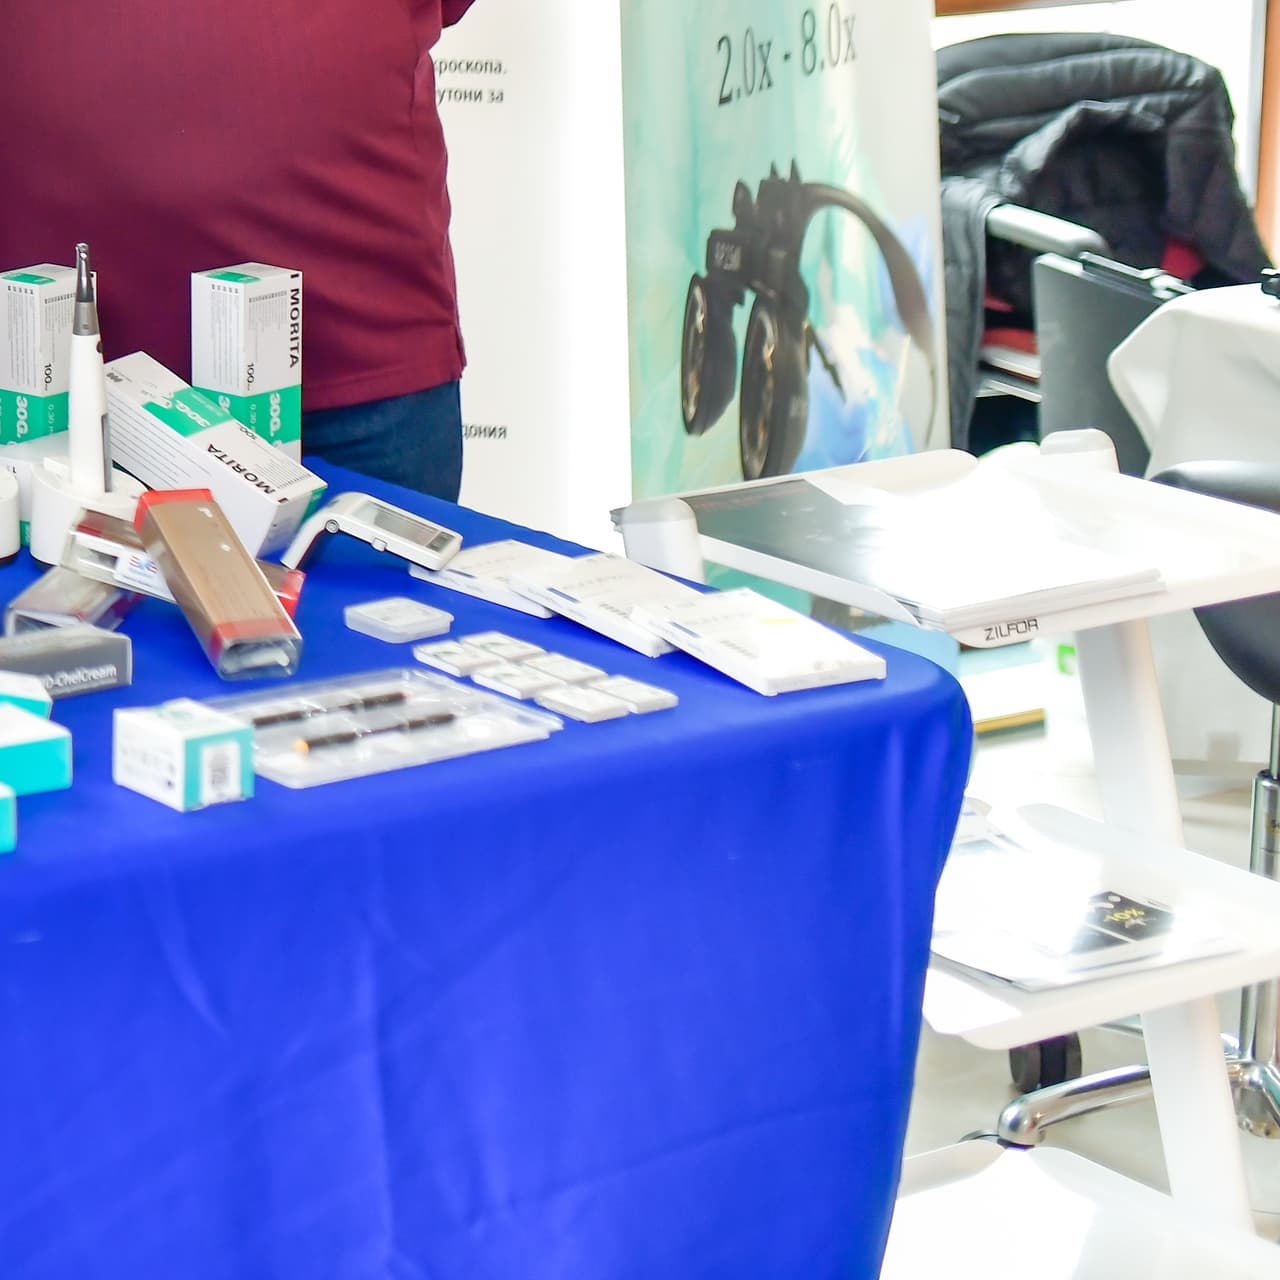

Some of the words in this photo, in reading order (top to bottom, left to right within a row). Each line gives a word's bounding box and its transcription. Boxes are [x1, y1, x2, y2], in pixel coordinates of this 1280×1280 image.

[433, 58, 508, 77] роскопа.
[289, 288, 301, 369] MORITA
[207, 443, 276, 495] MORITA
[983, 618, 1039, 641] ZILFOR
